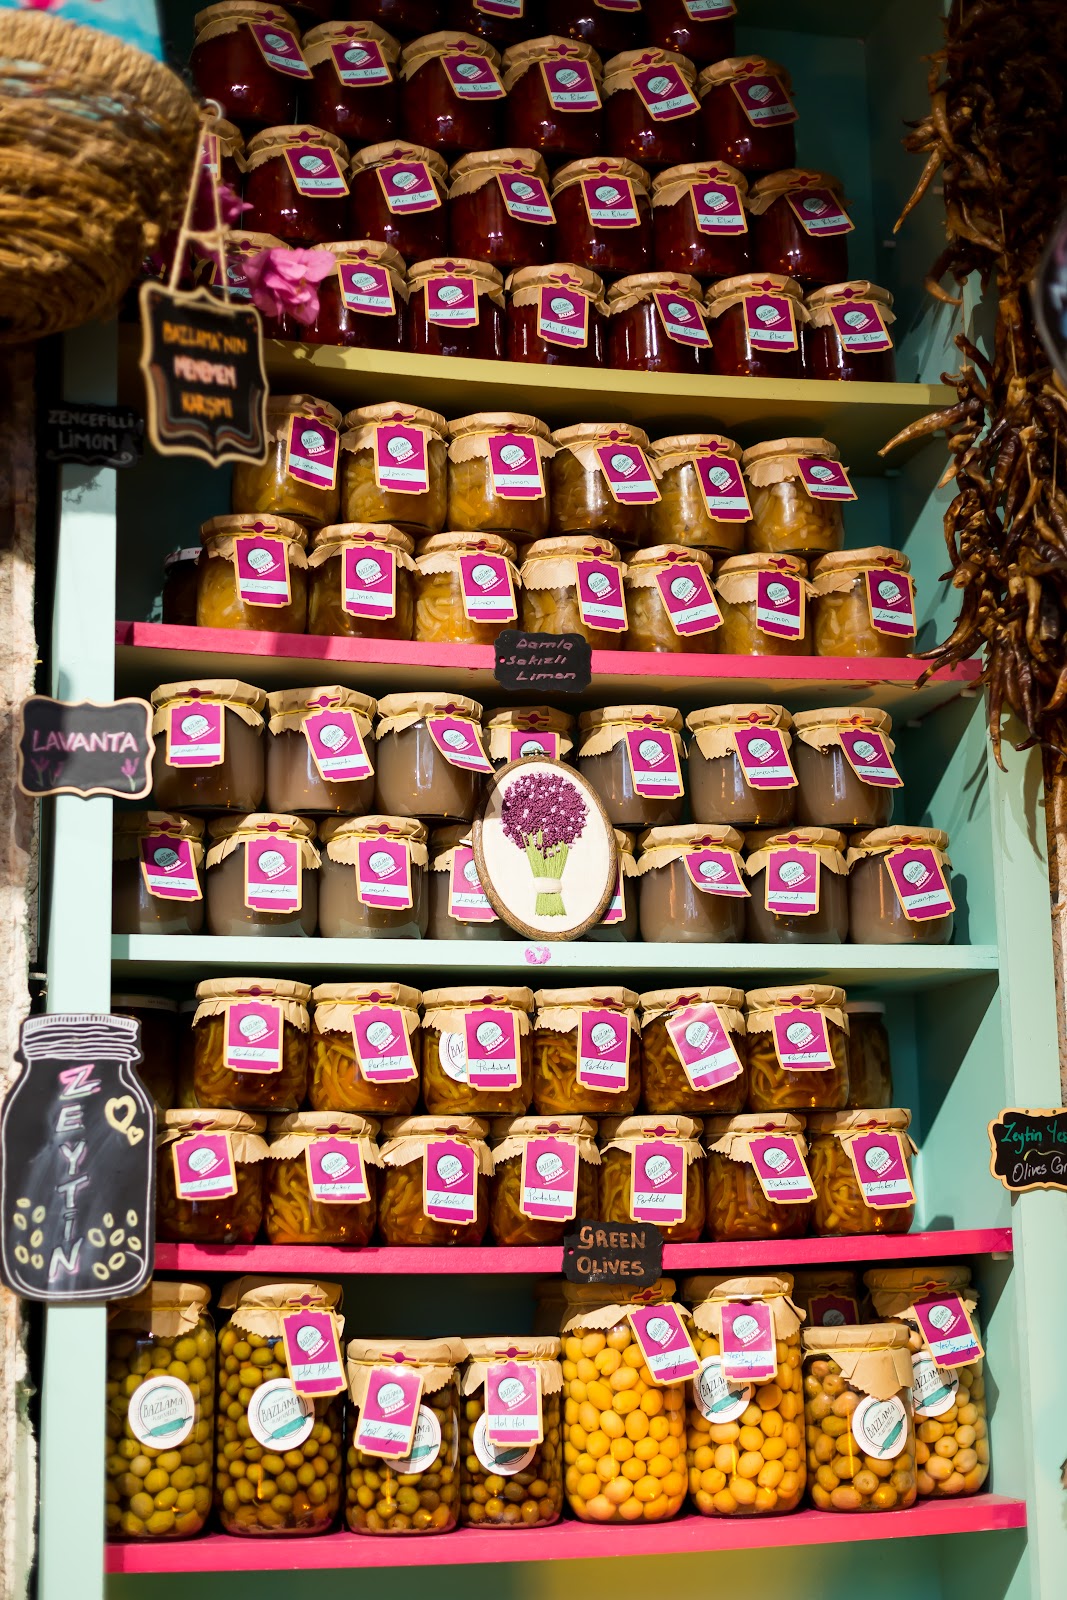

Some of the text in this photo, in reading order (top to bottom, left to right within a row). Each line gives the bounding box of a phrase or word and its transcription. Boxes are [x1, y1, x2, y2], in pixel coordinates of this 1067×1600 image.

[404, 179, 419, 190] BAZAAR
[605, 195, 621, 204] BAZAAR
[713, 200, 729, 210] BAZAAR
[361, 282, 378, 291] BAZAAR
[447, 294, 464, 305] BAZAAR
[558, 309, 575, 318] BAZAAR
[765, 316, 781, 325] BAZAAR
[855, 319, 869, 330] BAZAAR
[174, 355, 237, 389] MENEMEN
[308, 445, 325, 455] BAZAAR
[396, 450, 413, 462] BAZAAR
[510, 457, 526, 469] BAZAAR
[622, 465, 637, 476] BAZAAR
[501, 477, 529, 485] Limon
[719, 479, 733, 490] BAZAAR
[257, 562, 276, 574] BAZAAR
[365, 572, 382, 584] BAZAAR
[481, 578, 498, 589] BAZAAR
[596, 586, 612, 598] BAZAAR
[682, 587, 697, 602] BAZAAR
[775, 595, 791, 606] BAZAAR
[887, 594, 902, 605] BAZAAR
[516, 638, 573, 651] Damla
[516, 671, 576, 681] Limon
[191, 727, 210, 739] BAZAAR
[33, 729, 139, 753] LAVANTA
[332, 736, 348, 752] BAZAAR
[650, 753, 664, 765] BAZAAR
[760, 749, 774, 762] BAZAAR
[164, 860, 181, 872] BAZAAR
[269, 864, 286, 877] BAZAAR
[378, 863, 396, 876] BAZAAR
[788, 874, 806, 886] BAZAAR
[915, 872, 929, 886] BAZAAR
[249, 1028, 268, 1041] BAZAAR
[699, 1031, 714, 1051] BAZAAR
[797, 1034, 813, 1047] BAZAAR
[378, 1035, 394, 1050] BAZAAR
[486, 1037, 504, 1051] BAZAAR
[599, 1039, 617, 1051] BAZAAR
[1001, 1122, 1043, 1155] Zeytin
[200, 1159, 218, 1175] BAZAAR
[776, 1158, 791, 1172] BAZAAR
[877, 1159, 892, 1175] BAZAAR
[332, 1167, 350, 1179] BAZAAR
[445, 1171, 463, 1185] BAZAAR
[545, 1168, 564, 1181] BAZAAR
[654, 1170, 671, 1184] BAZAAR
[1012, 1163, 1047, 1183] Olives
[577, 1225, 646, 1250] GREEN
[942, 1317, 957, 1333] BAZAAR
[659, 1328, 674, 1344] BAZAAR
[742, 1329, 761, 1343] BAZAAR
[308, 1340, 324, 1355] BAZAAR
[507, 1393, 526, 1407] BAZAAR
[143, 1397, 183, 1418] BAZLAMA
[261, 1396, 301, 1423] BAZLAMA
[384, 1400, 404, 1414] BAZAAR
[866, 1405, 896, 1439] BAZLAMA
